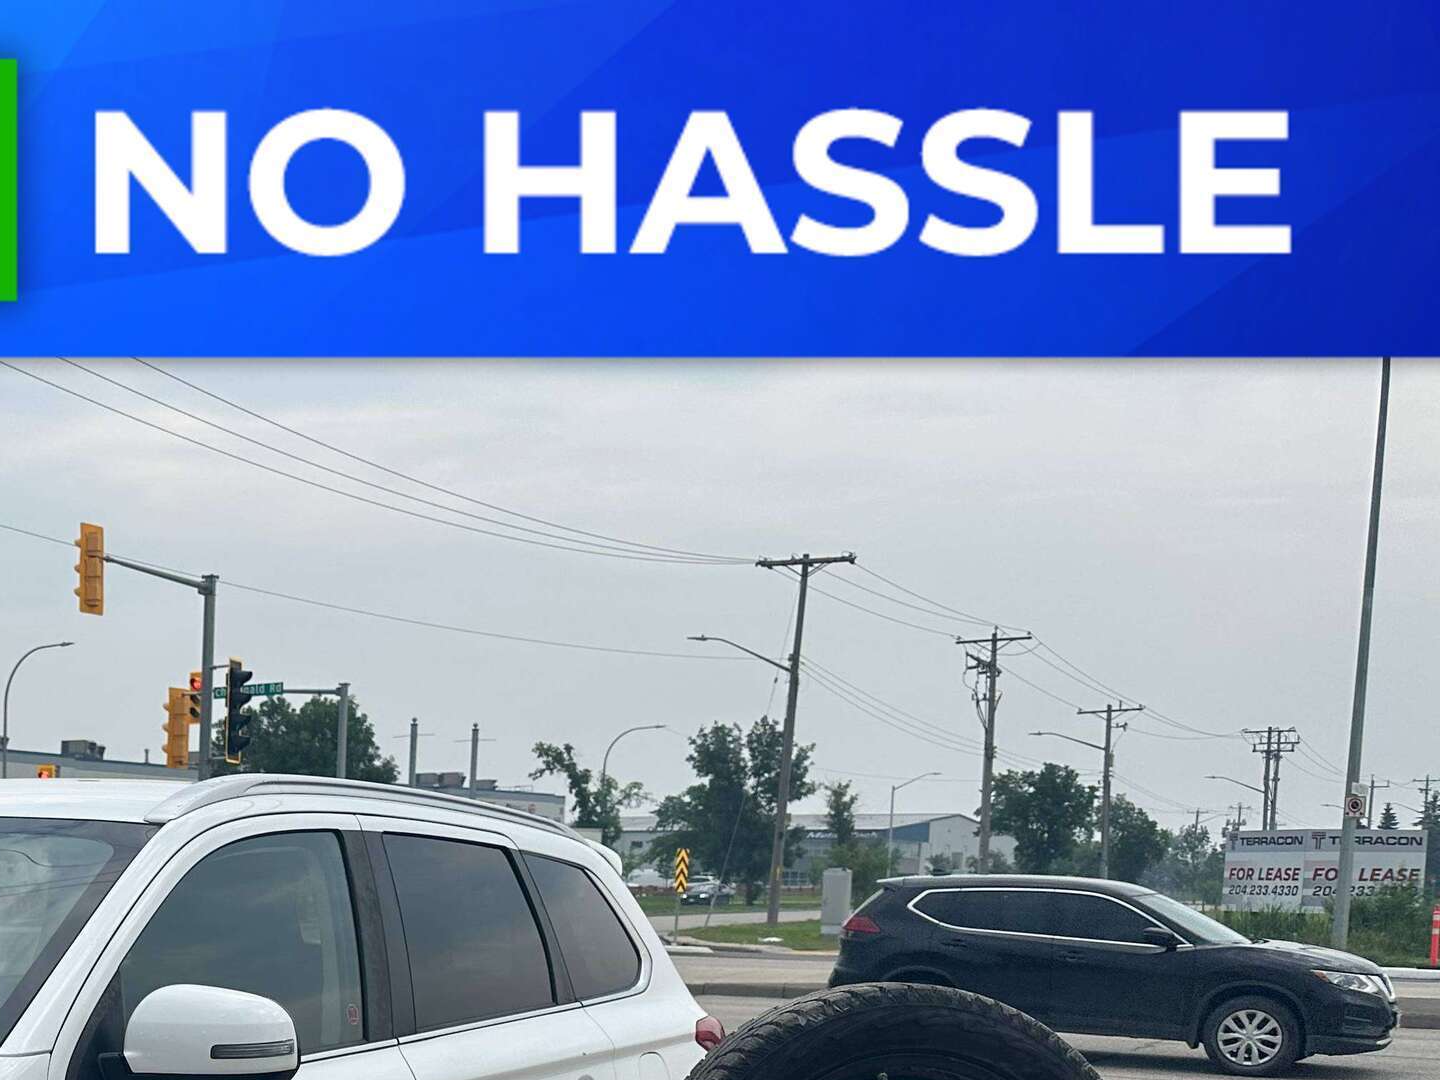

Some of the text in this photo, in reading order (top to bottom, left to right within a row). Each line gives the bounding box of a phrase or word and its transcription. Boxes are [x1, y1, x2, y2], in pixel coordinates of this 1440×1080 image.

[1240, 835, 1304, 847] TERRACON
[1329, 836, 1423, 847] TRRACON
[1228, 867, 1302, 881] FOR LEASE
[1312, 867, 1421, 882] FO LEASE
[1228, 884, 1300, 897] 204.233.4330
